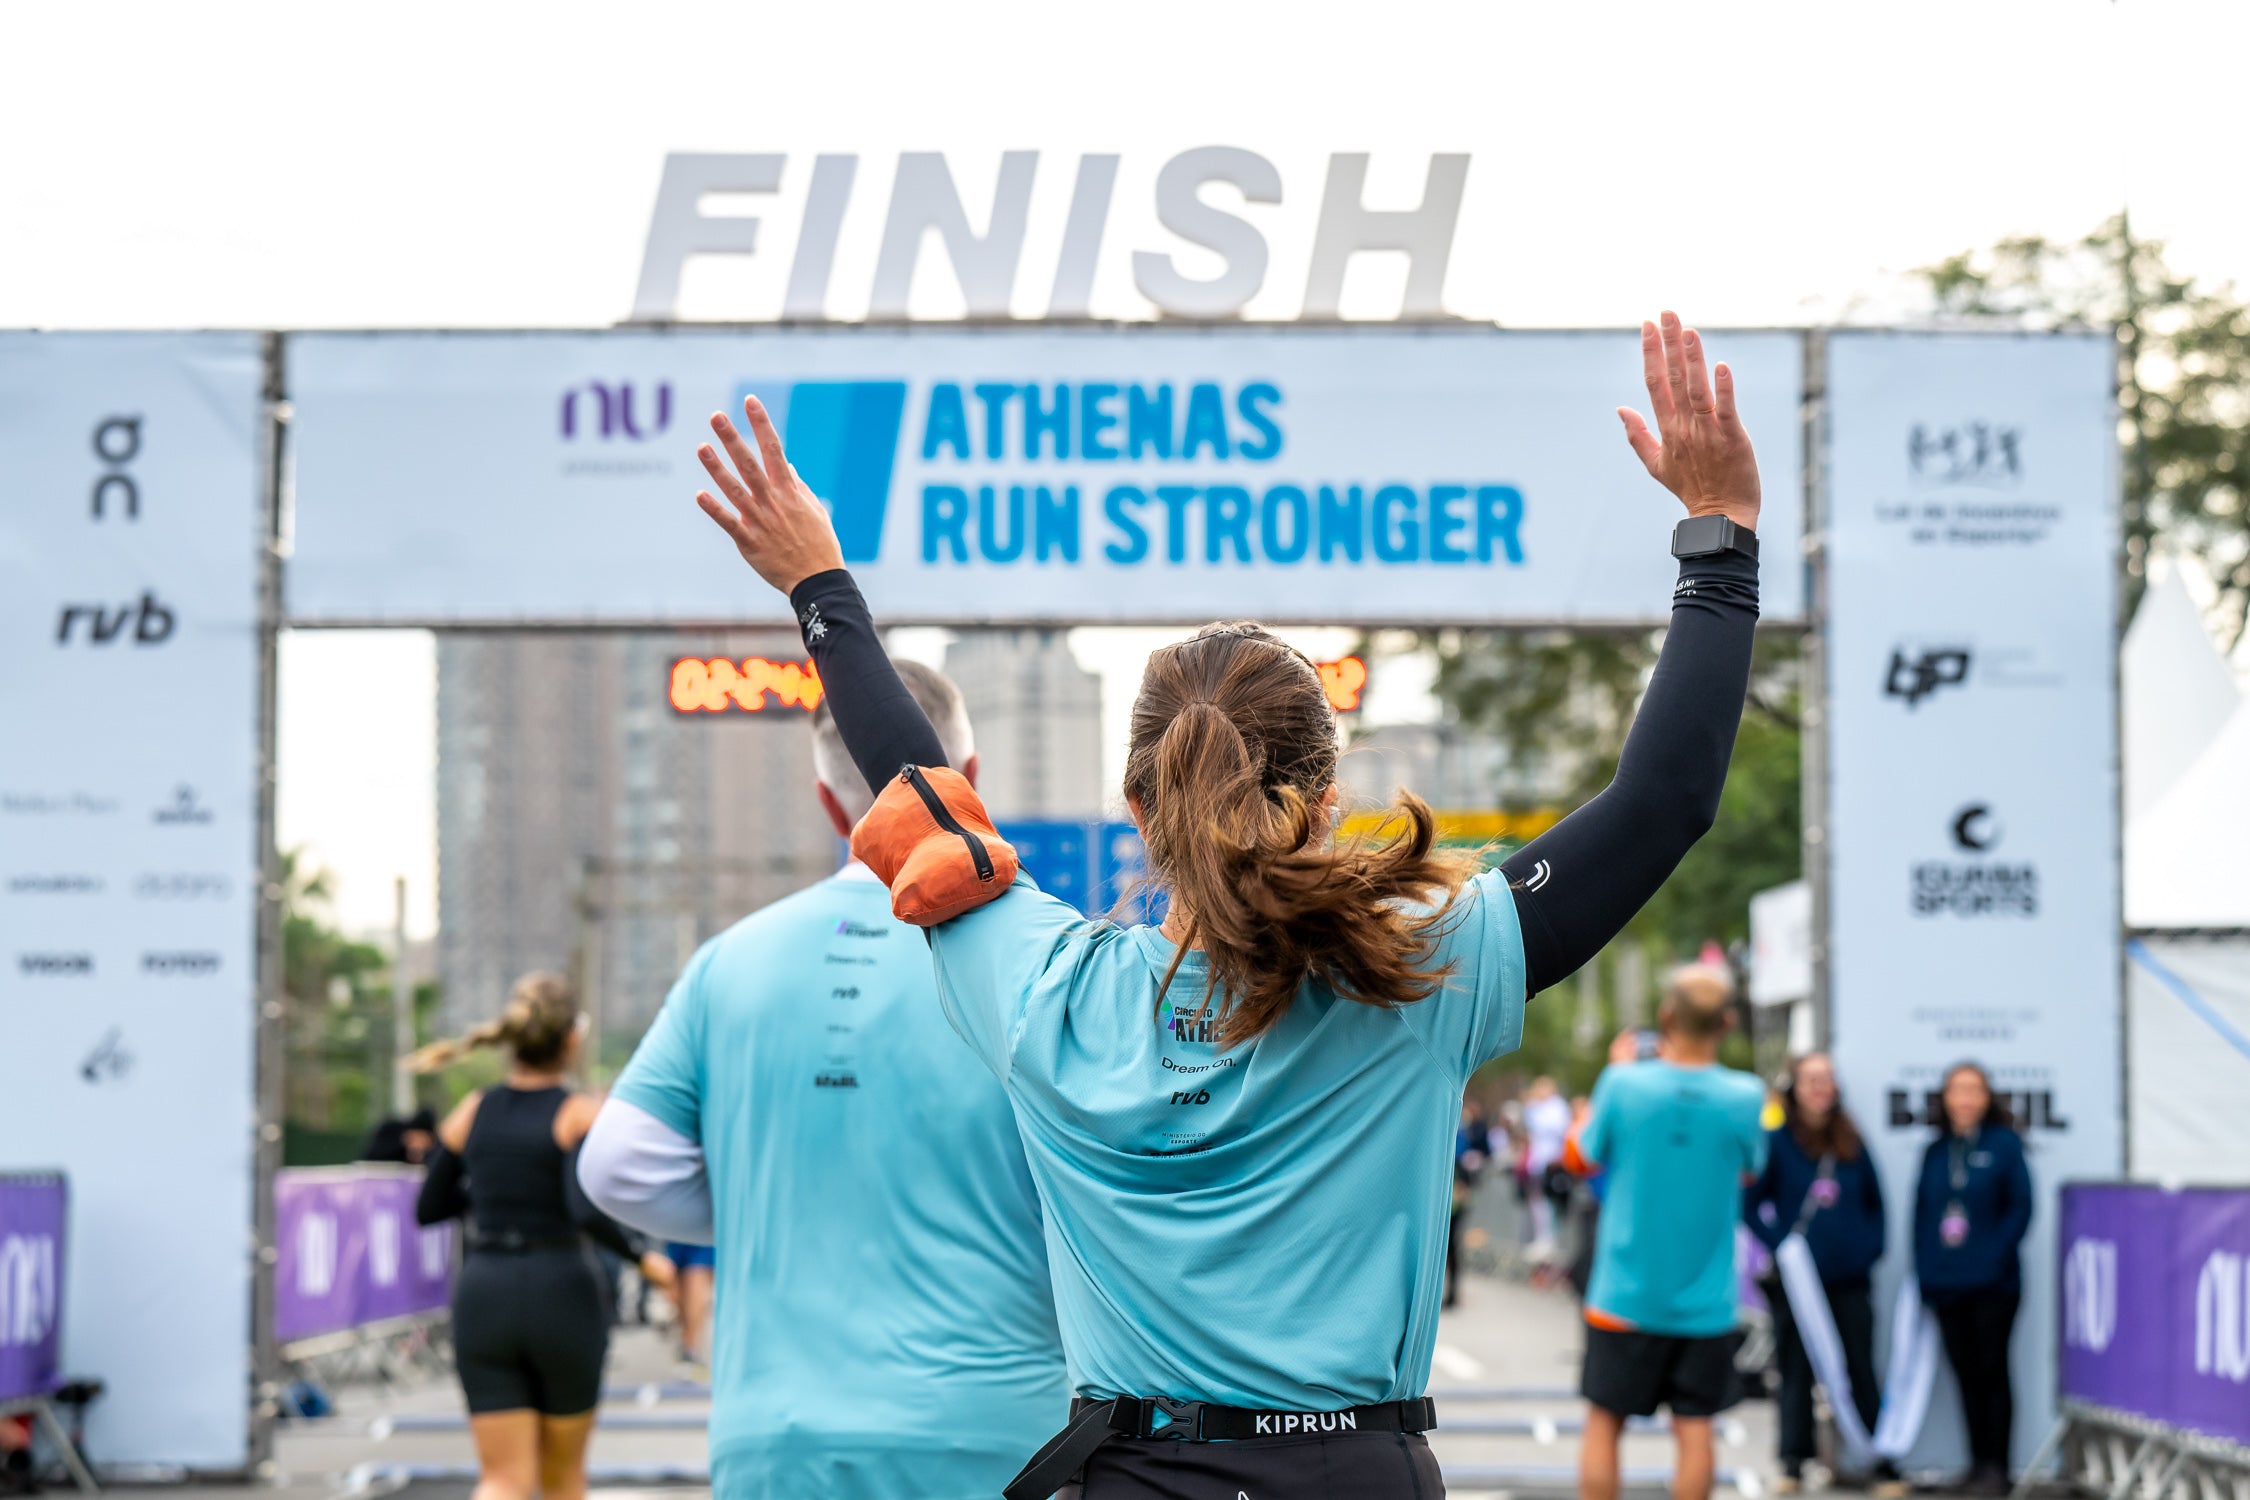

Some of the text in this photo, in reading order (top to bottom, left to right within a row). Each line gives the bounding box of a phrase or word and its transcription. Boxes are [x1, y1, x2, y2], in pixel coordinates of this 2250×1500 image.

[632, 145, 1472, 319] FINISH
[921, 382, 1283, 460] ATHENAS
[921, 485, 1525, 564] RUN STRONGER
[1161, 1056, 1238, 1074] Dream On.
[1170, 1088, 1211, 1105] rvb
[1255, 1411, 1357, 1436] KIPRUN
